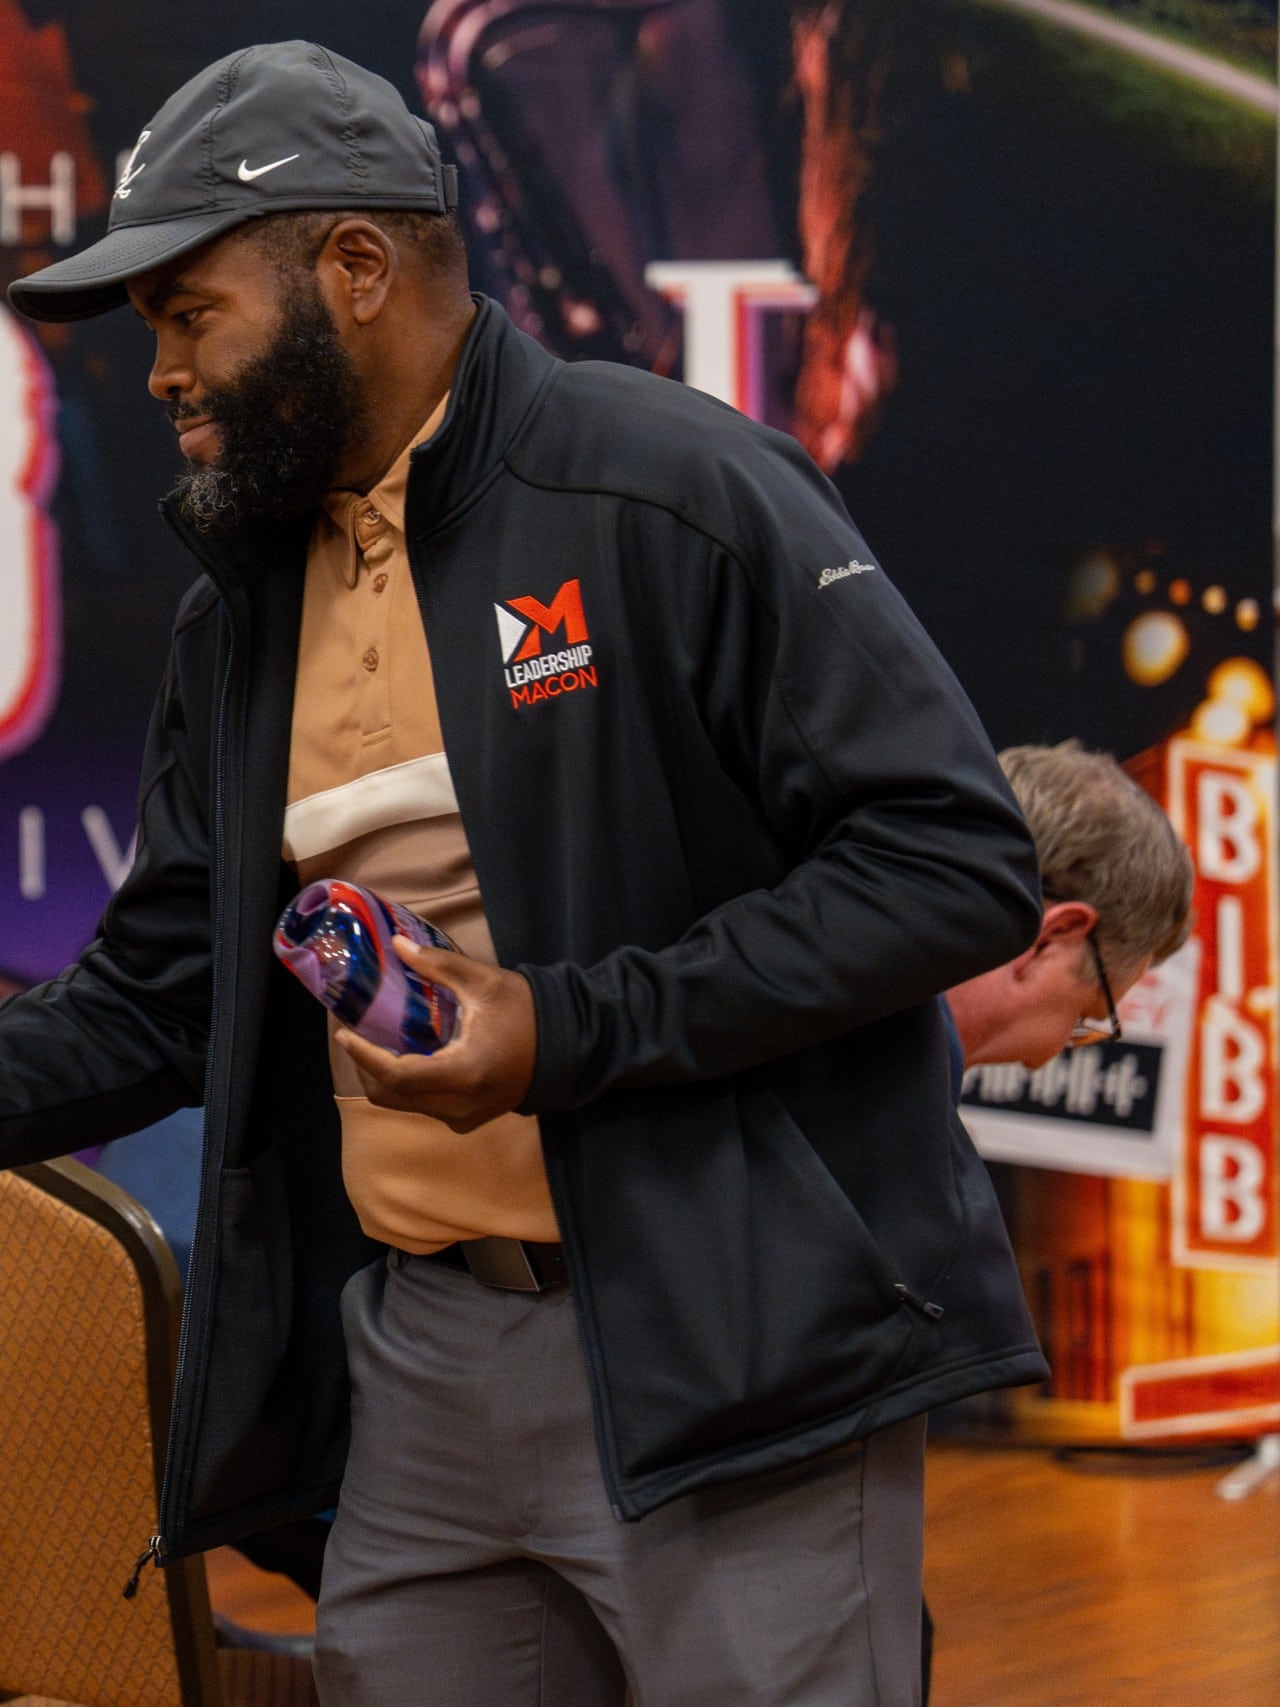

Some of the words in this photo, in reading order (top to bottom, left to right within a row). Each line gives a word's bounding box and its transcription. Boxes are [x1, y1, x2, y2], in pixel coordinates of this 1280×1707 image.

[504, 645, 592, 688] LEADERSHIP
[510, 665, 598, 710] MACON
[1198, 770, 1265, 1242] BIBB
